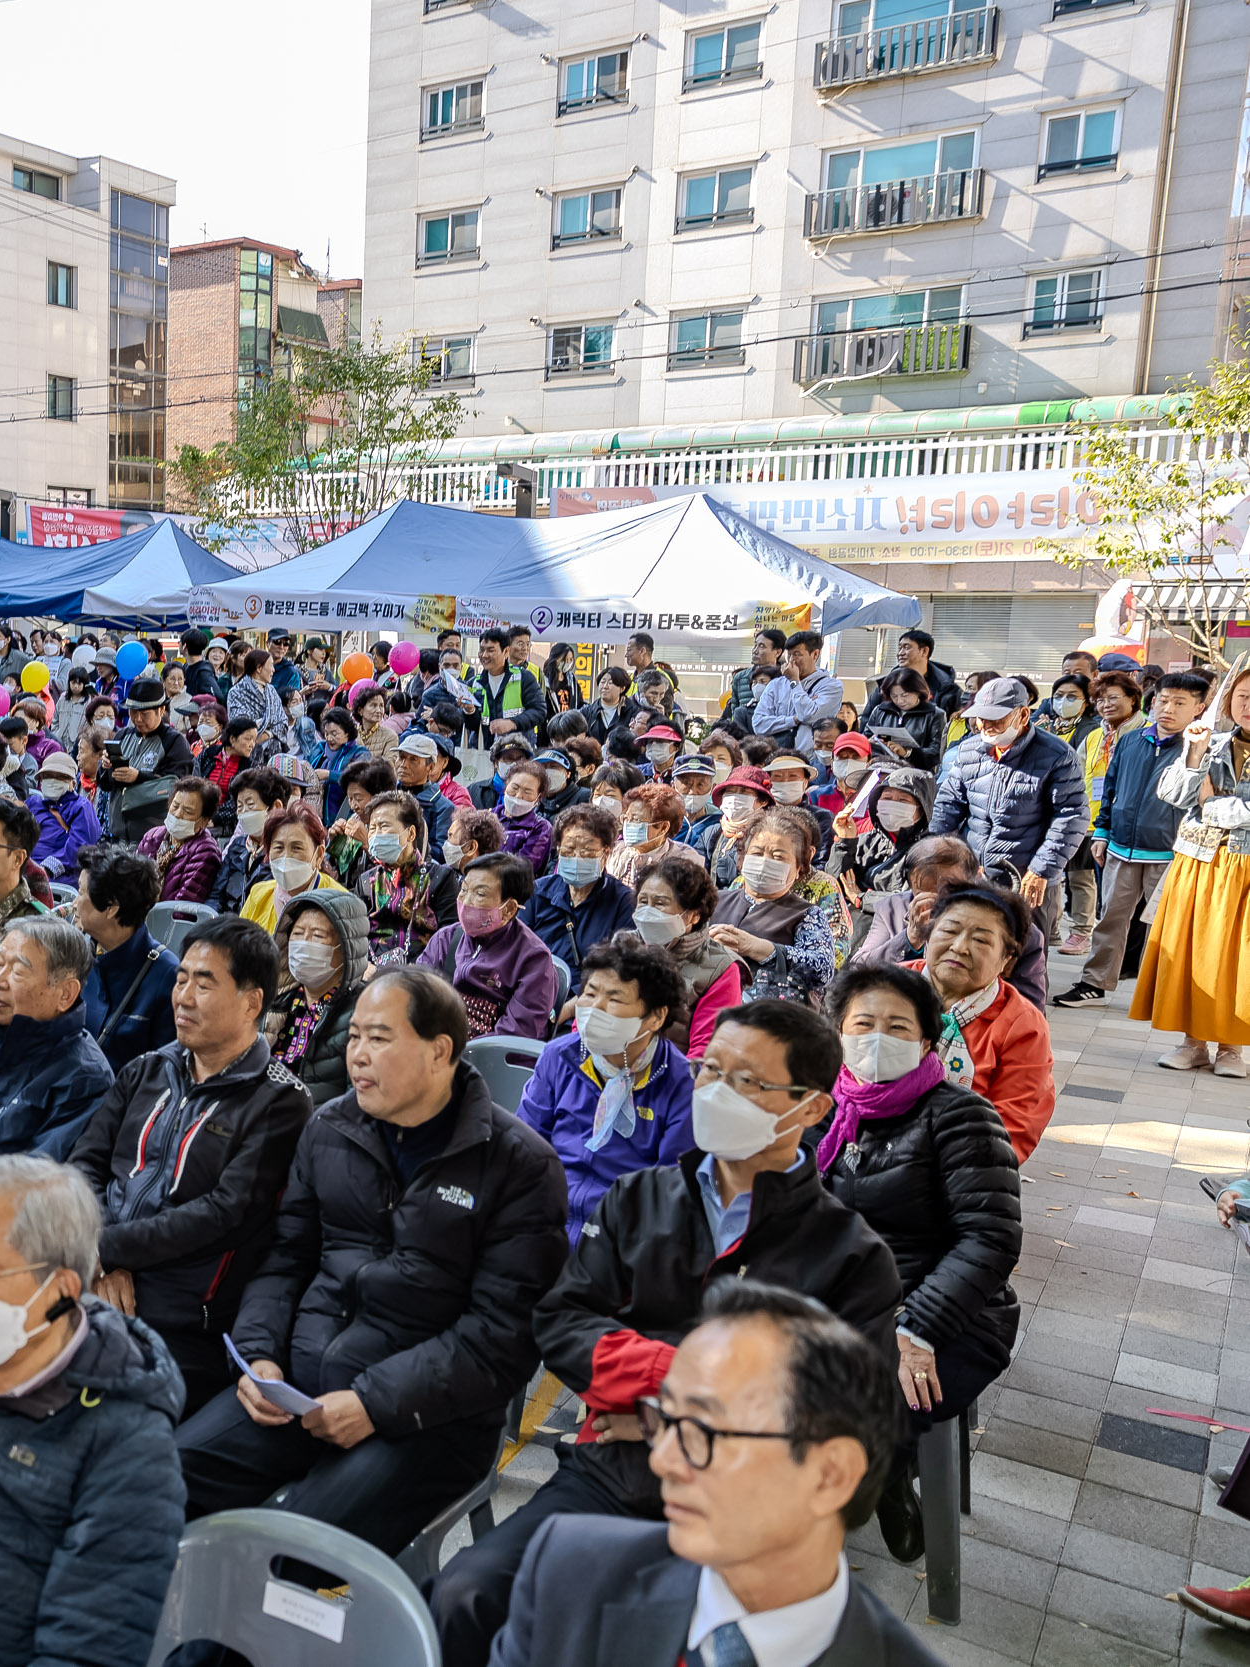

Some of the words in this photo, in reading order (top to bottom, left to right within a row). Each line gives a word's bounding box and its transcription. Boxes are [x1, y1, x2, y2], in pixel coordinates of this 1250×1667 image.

[250, 600, 257, 612] 3
[264, 599, 295, 616] 할로윈
[371, 603, 406, 620] 꾸미기
[537, 611, 546, 625] 2
[556, 611, 600, 630] 캐릭터
[605, 611, 652, 631] 스티커
[657, 613, 739, 632] 타투&풍선
[754, 615, 778, 623] 신나는
